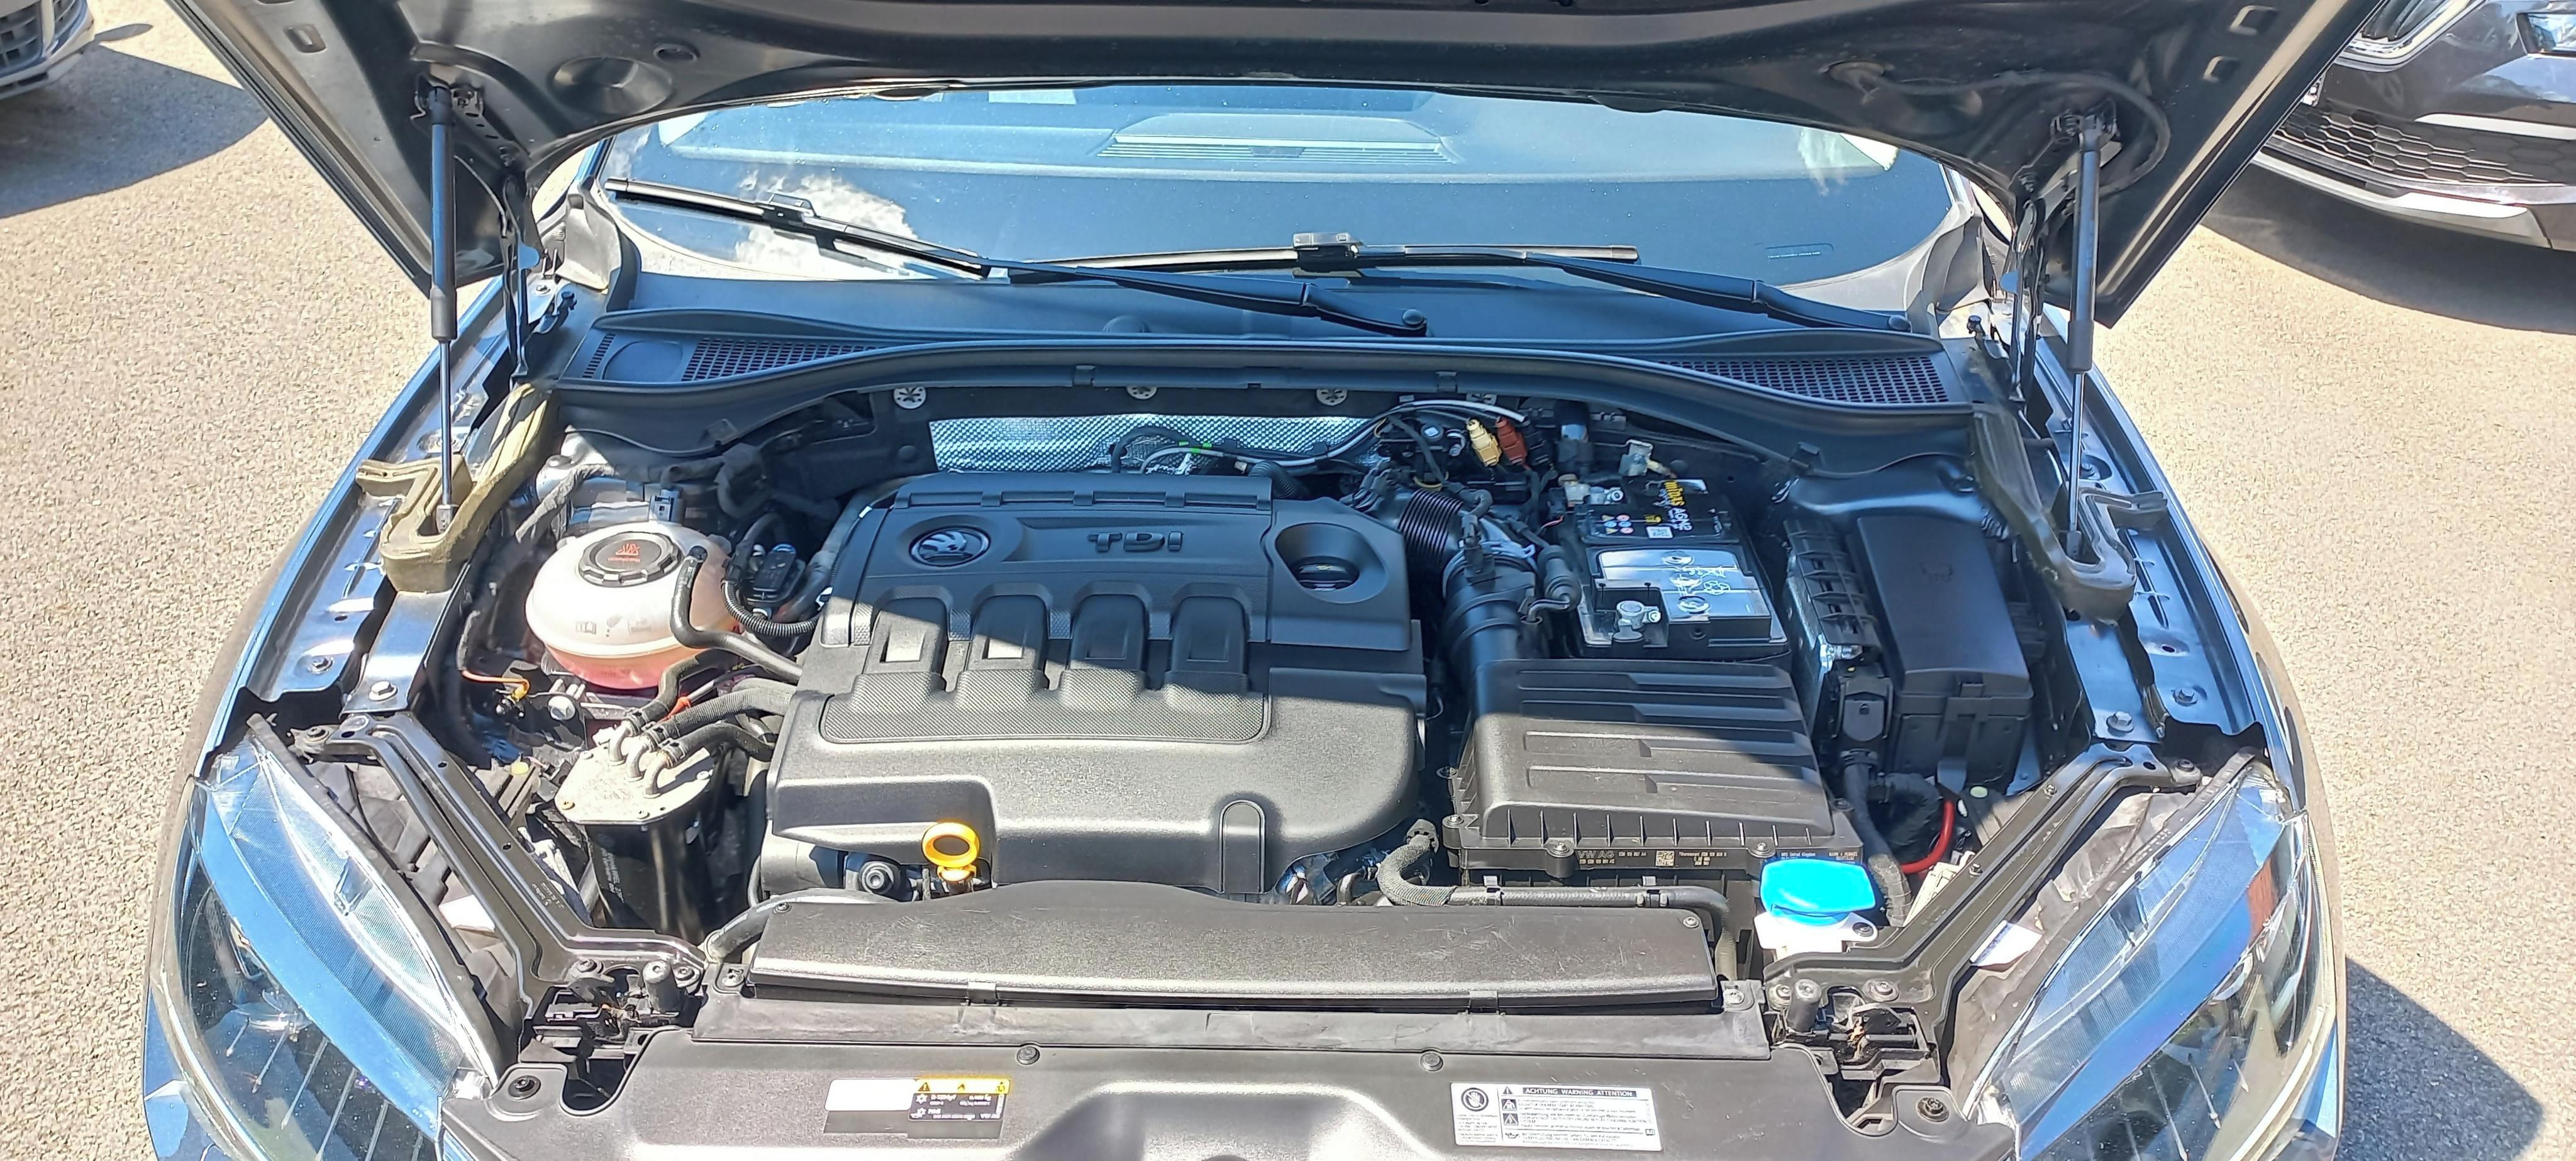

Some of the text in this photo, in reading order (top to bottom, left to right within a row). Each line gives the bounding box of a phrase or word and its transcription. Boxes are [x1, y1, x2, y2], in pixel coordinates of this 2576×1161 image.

[1087, 531, 1184, 553] TDI
[1577, 850, 1614, 859] VW AG
